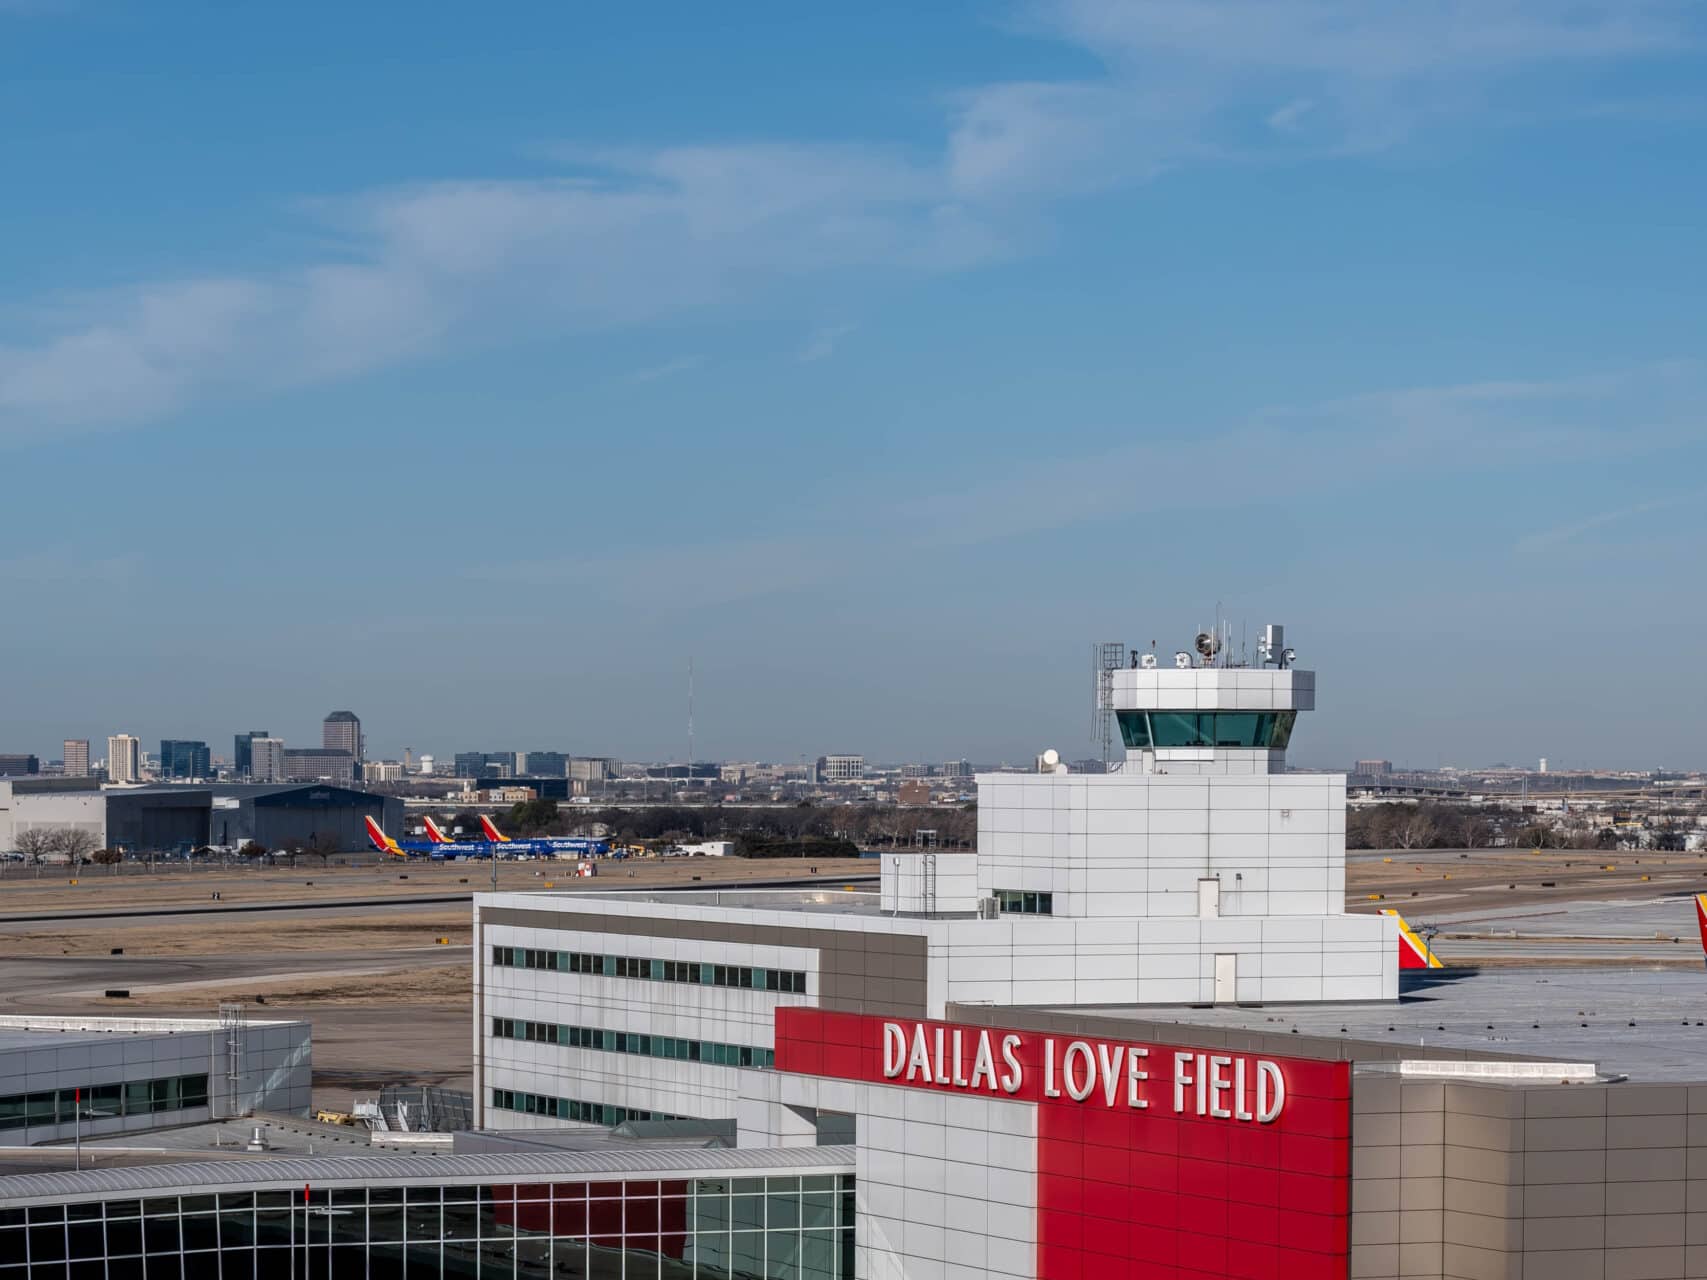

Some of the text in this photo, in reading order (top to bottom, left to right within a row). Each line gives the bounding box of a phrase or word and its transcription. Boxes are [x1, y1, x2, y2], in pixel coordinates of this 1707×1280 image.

[439, 843, 475, 851] Southwest
[552, 841, 587, 849] Southwest
[884, 1022, 1285, 1123] DALLAS LOVE FIELD
